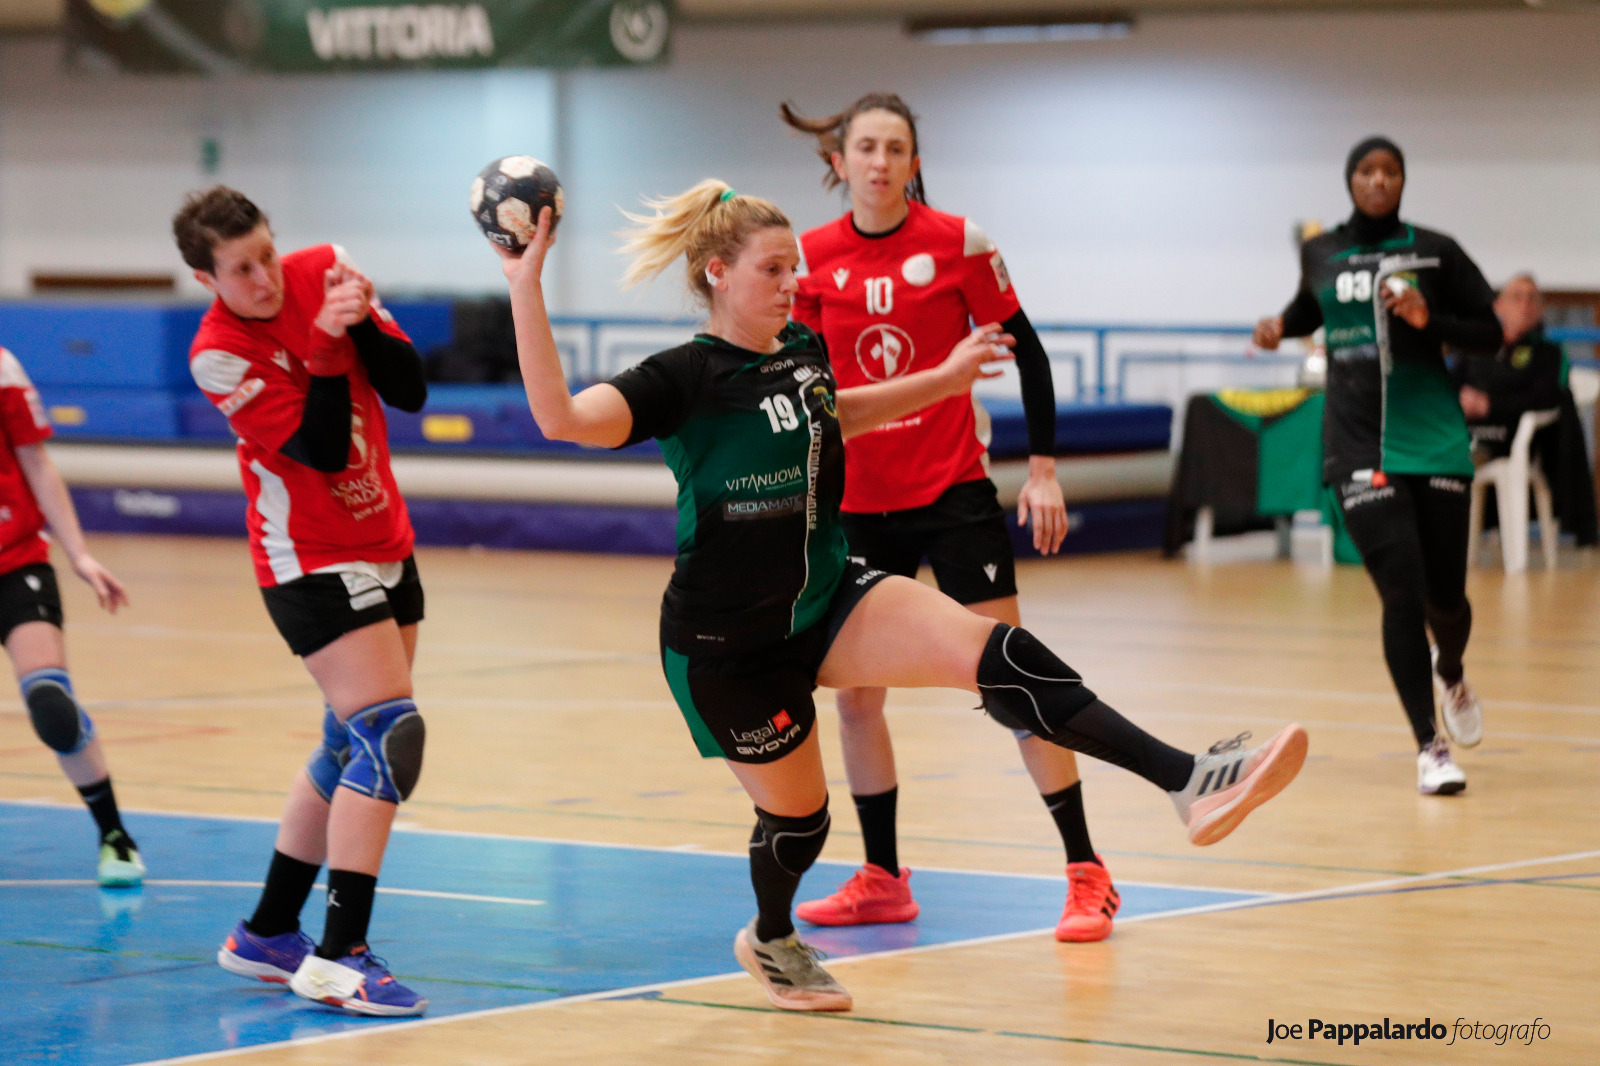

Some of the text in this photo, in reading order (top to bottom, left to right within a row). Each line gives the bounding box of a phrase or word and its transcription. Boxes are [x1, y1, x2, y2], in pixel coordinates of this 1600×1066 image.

[306, 4, 495, 60] VITTORIA
[864, 276, 894, 315] 10
[1336, 269, 1372, 303] 93
[760, 359, 795, 373] GIVOVA
[759, 394, 799, 433] 19
[726, 465, 802, 493] VITANUOVA
[730, 719, 776, 744] Legal
